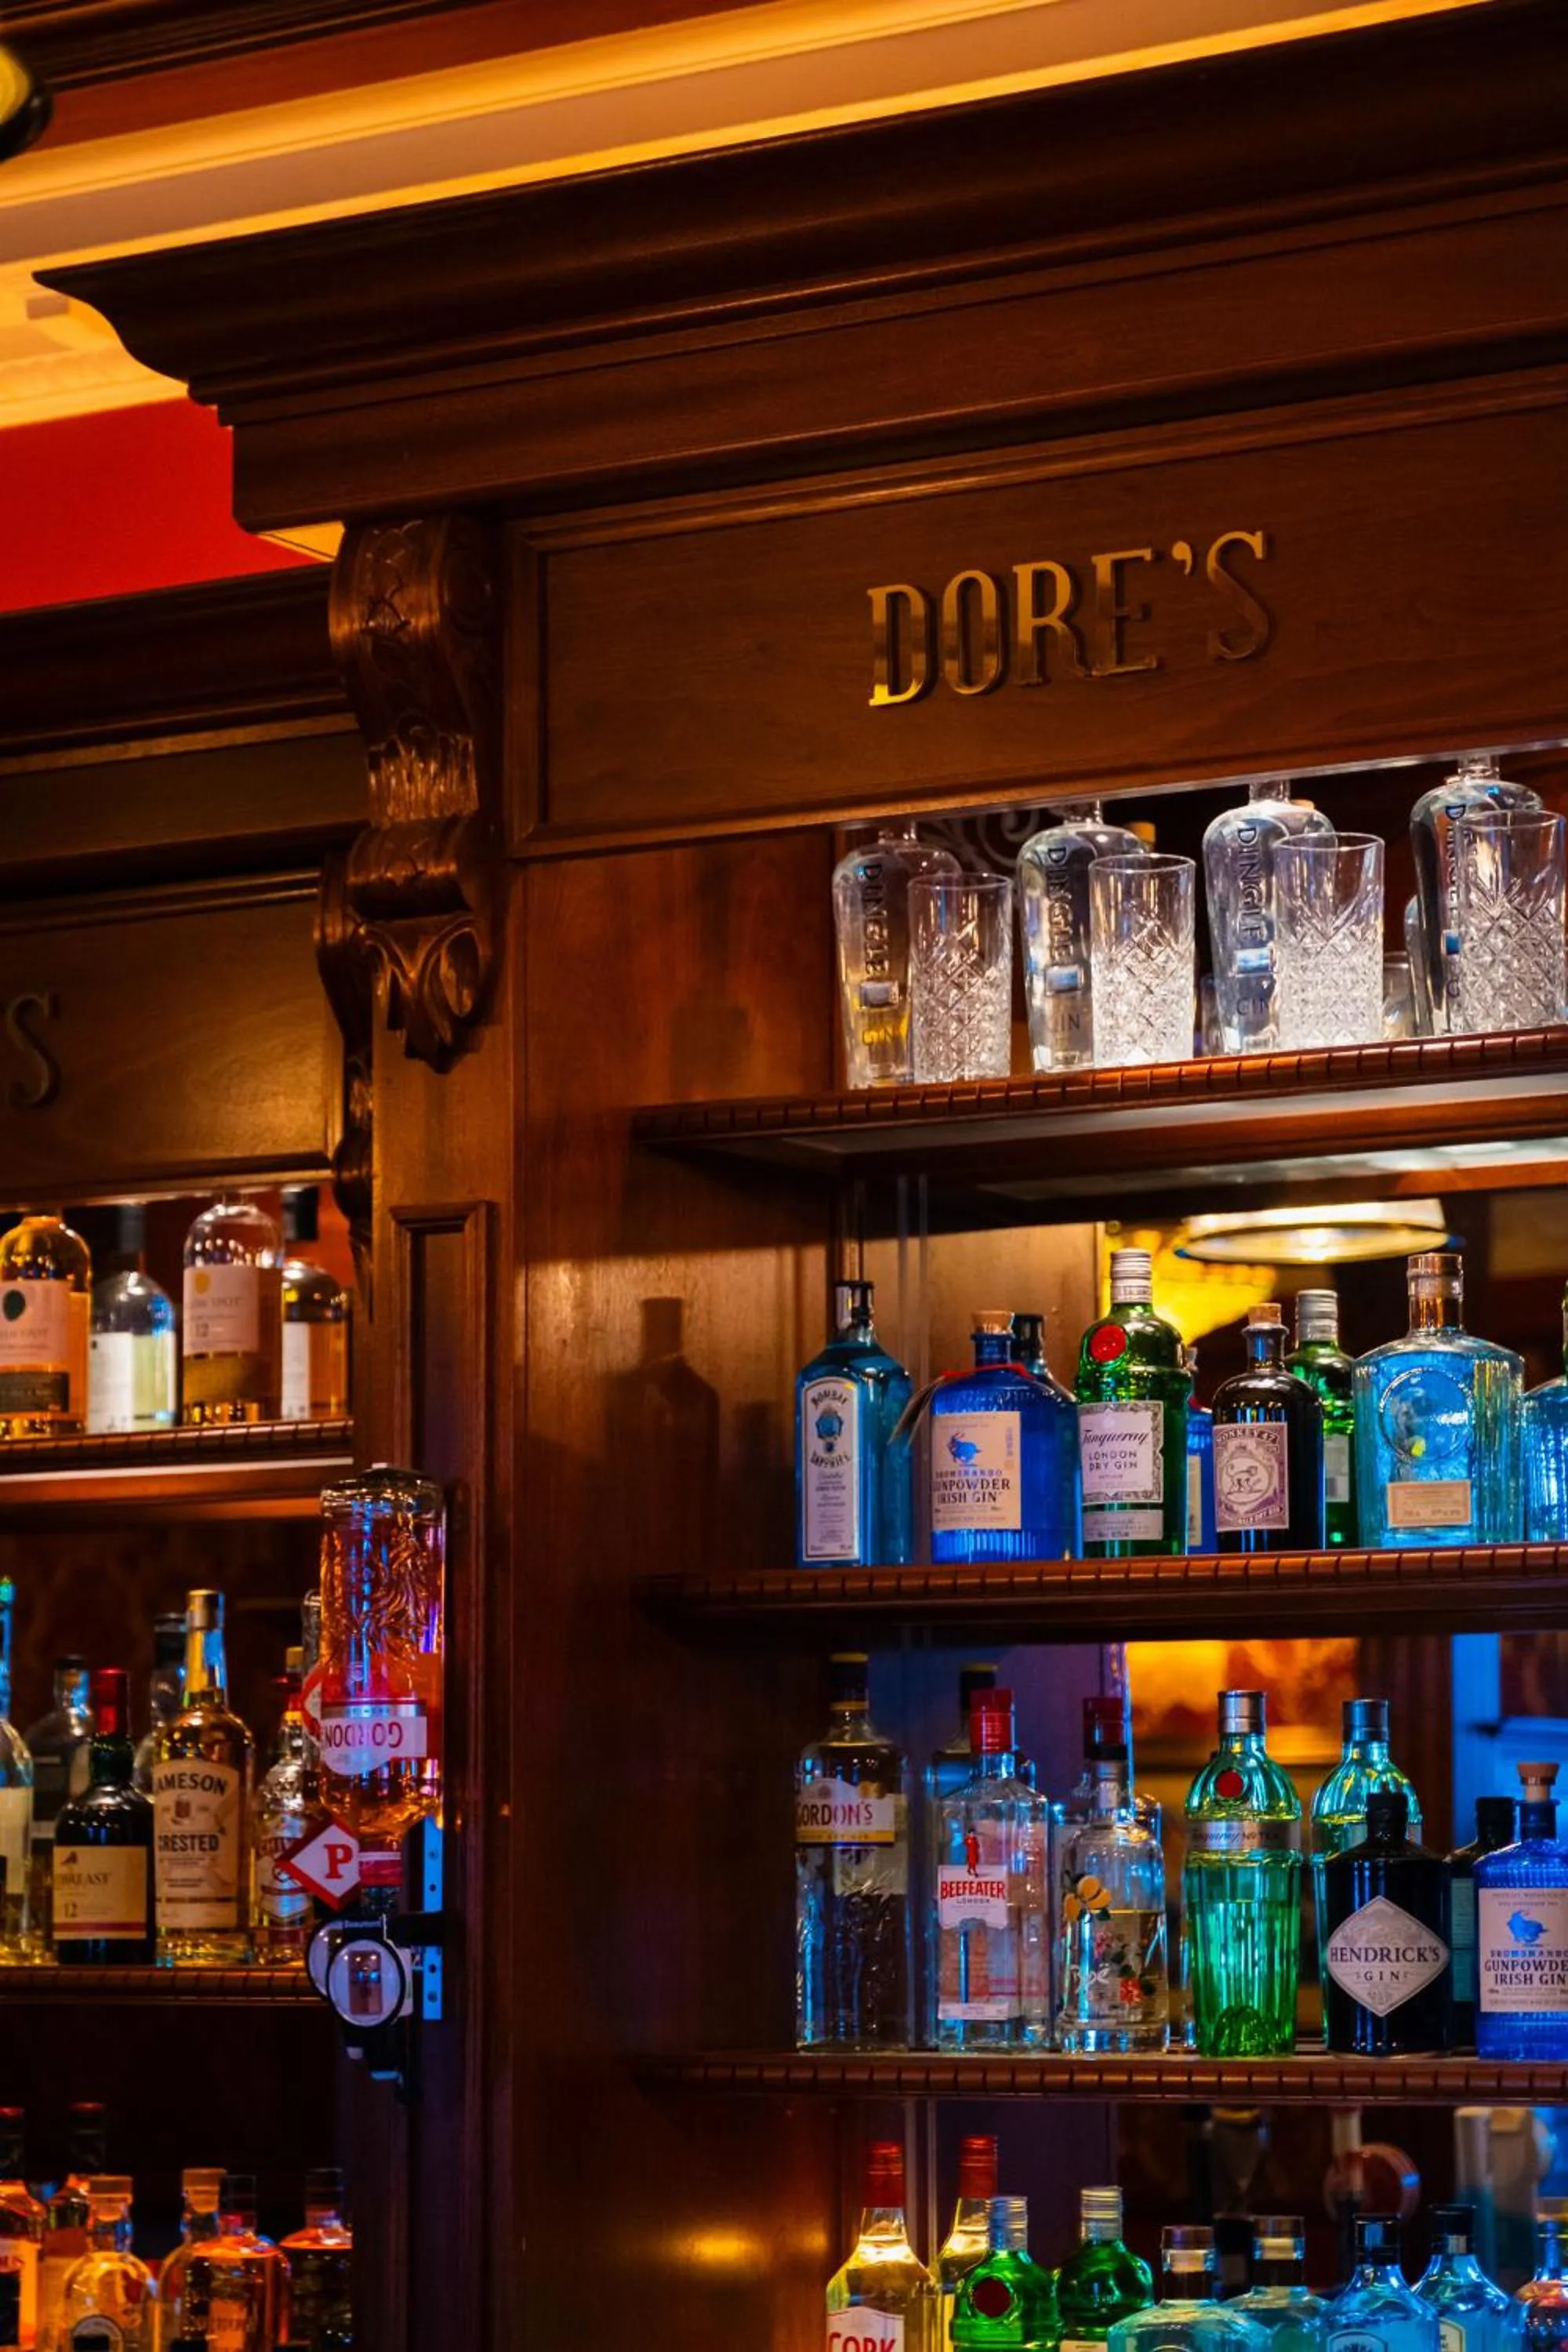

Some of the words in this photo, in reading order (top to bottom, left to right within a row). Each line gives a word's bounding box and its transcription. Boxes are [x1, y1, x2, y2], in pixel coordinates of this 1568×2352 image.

[867, 530, 1271, 706] DORE'S
[1237, 826, 1267, 942] DINGLE
[1047, 848, 1075, 961] DINGLE
[862, 865, 890, 978] DINGLE
[1084, 1430, 1149, 1447] Tanqueray
[1089, 1450, 1138, 1460] LONDON
[1089, 1461, 1109, 1472] DRY
[1114, 1461, 1138, 1470] GIN
[973, 1491, 997, 1503] GIN
[941, 1881, 1006, 1900] BEEFEATER
[1330, 1946, 1440, 1962] HENDRICK'S
[1484, 1959, 1568, 1972] GUNPOWDE
[1364, 1970, 1399, 1982] GIN
[1494, 1974, 1534, 1985] IRISH
[1539, 1973, 1566, 1985] GIN
